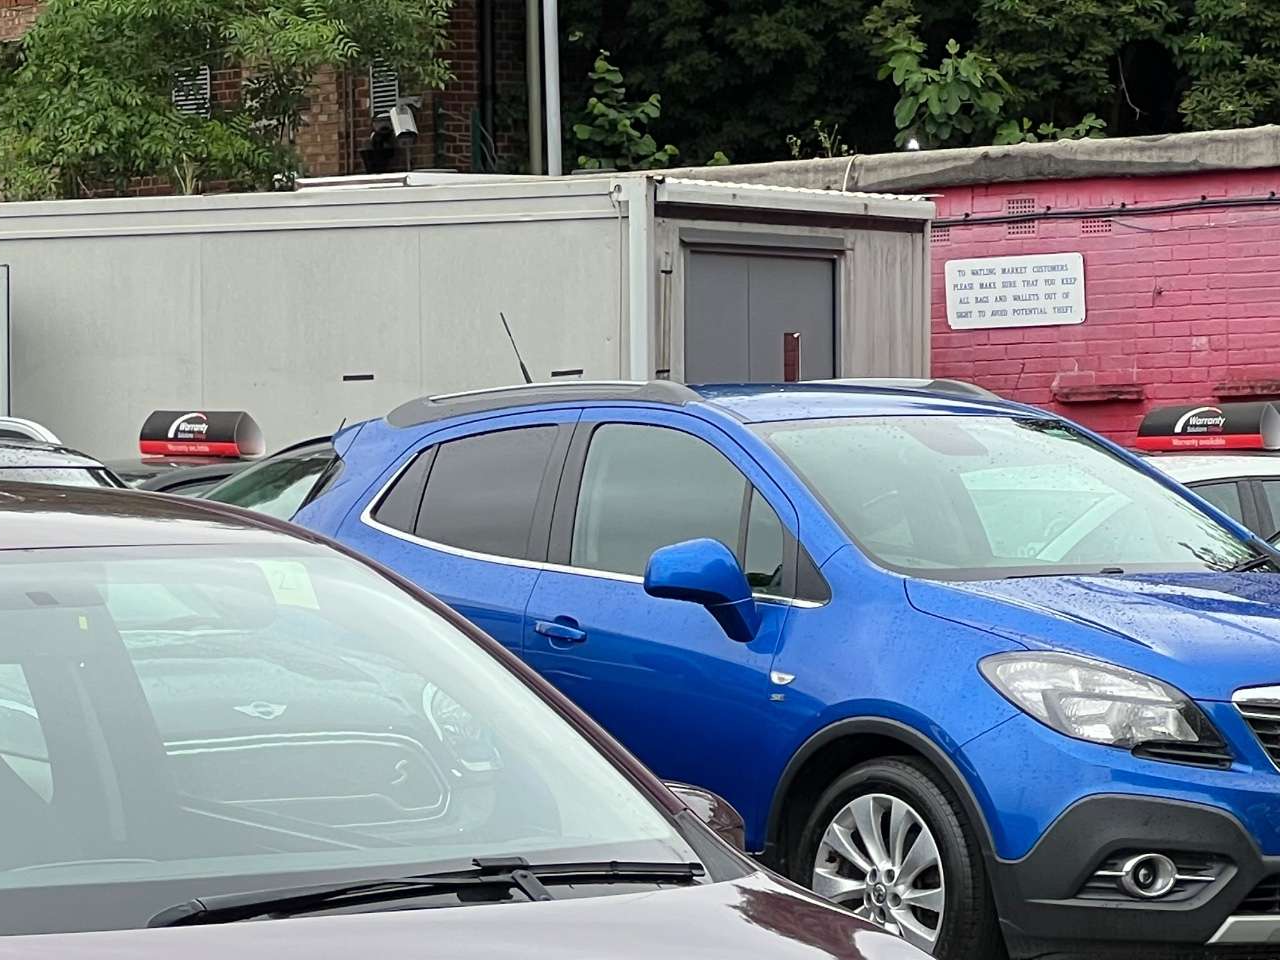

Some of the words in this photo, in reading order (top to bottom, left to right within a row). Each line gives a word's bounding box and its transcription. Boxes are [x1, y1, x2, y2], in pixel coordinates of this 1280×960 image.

[1001, 266, 1027, 275] MARKET
[1032, 264, 1068, 273] CUSTOMERS
[953, 283, 974, 291] PLEASE
[1001, 280, 1017, 288] SURE
[1022, 279, 1038, 287] THAT
[1061, 277, 1077, 285] KEEP
[1013, 293, 1039, 301] WALLETS
[956, 311, 972, 319] SIGHT
[991, 309, 1008, 317] AVOID
[1012, 307, 1047, 316] POTENTIAL
[1189, 416, 1226, 427] Warranty
[180, 422, 208, 433] Warranty
